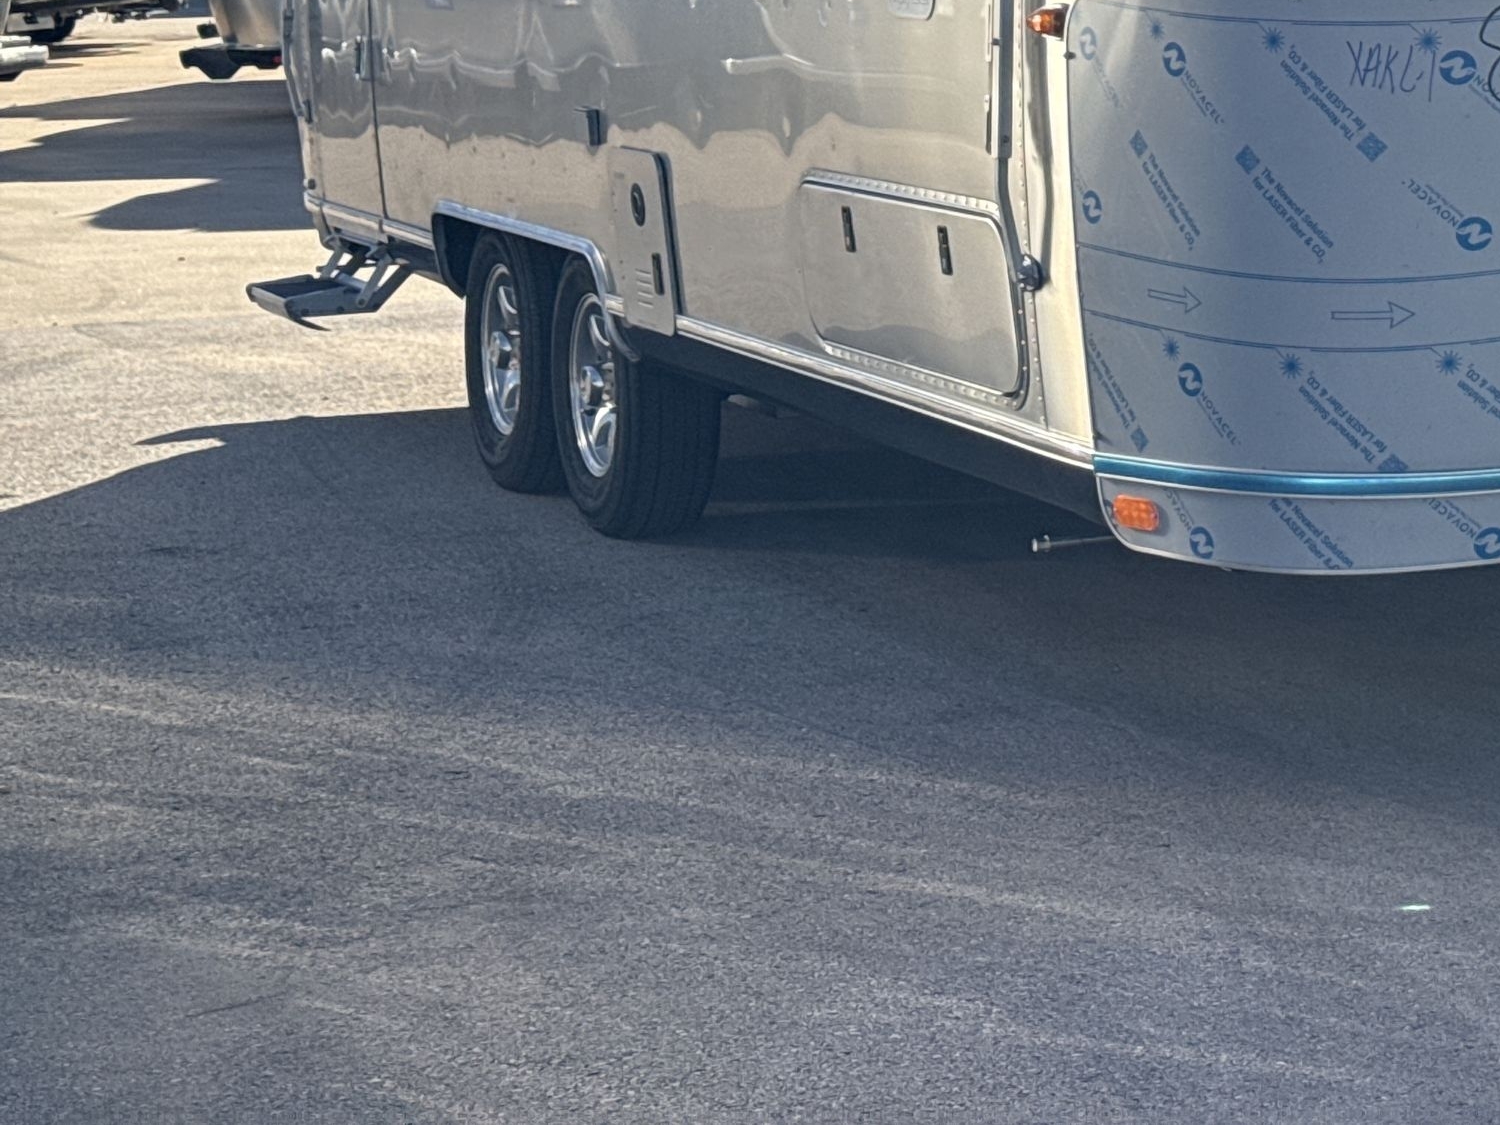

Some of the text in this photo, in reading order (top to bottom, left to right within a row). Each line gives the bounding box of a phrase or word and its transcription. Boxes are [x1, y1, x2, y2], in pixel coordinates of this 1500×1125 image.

[1280, 59, 1355, 141] The Novacel Solution
[1307, 70, 1329, 93] Fiber
[1326, 89, 1355, 120] LASER
[1352, 115, 1367, 132] for
[1252, 176, 1265, 191] for
[1262, 188, 1289, 218] LASER
[1285, 215, 1307, 238] Fiber
[1261, 167, 1334, 248] The Novacel Solution
[1407, 178, 1460, 227] NOVACEL
[1200, 391, 1237, 446] NOVACEL
[1326, 395, 1349, 418] Fiber
[1457, 379, 1491, 411] Solution
[1298, 386, 1376, 464] The Novacel Solution
[1346, 413, 1376, 442] LASER
[1373, 438, 1388, 454] for
[1268, 498, 1282, 513] for
[1279, 510, 1307, 540] LASER
[1304, 536, 1326, 559] Fiber
[1291, 505, 1325, 538] Novacel
[1320, 535, 1354, 569] Solution
